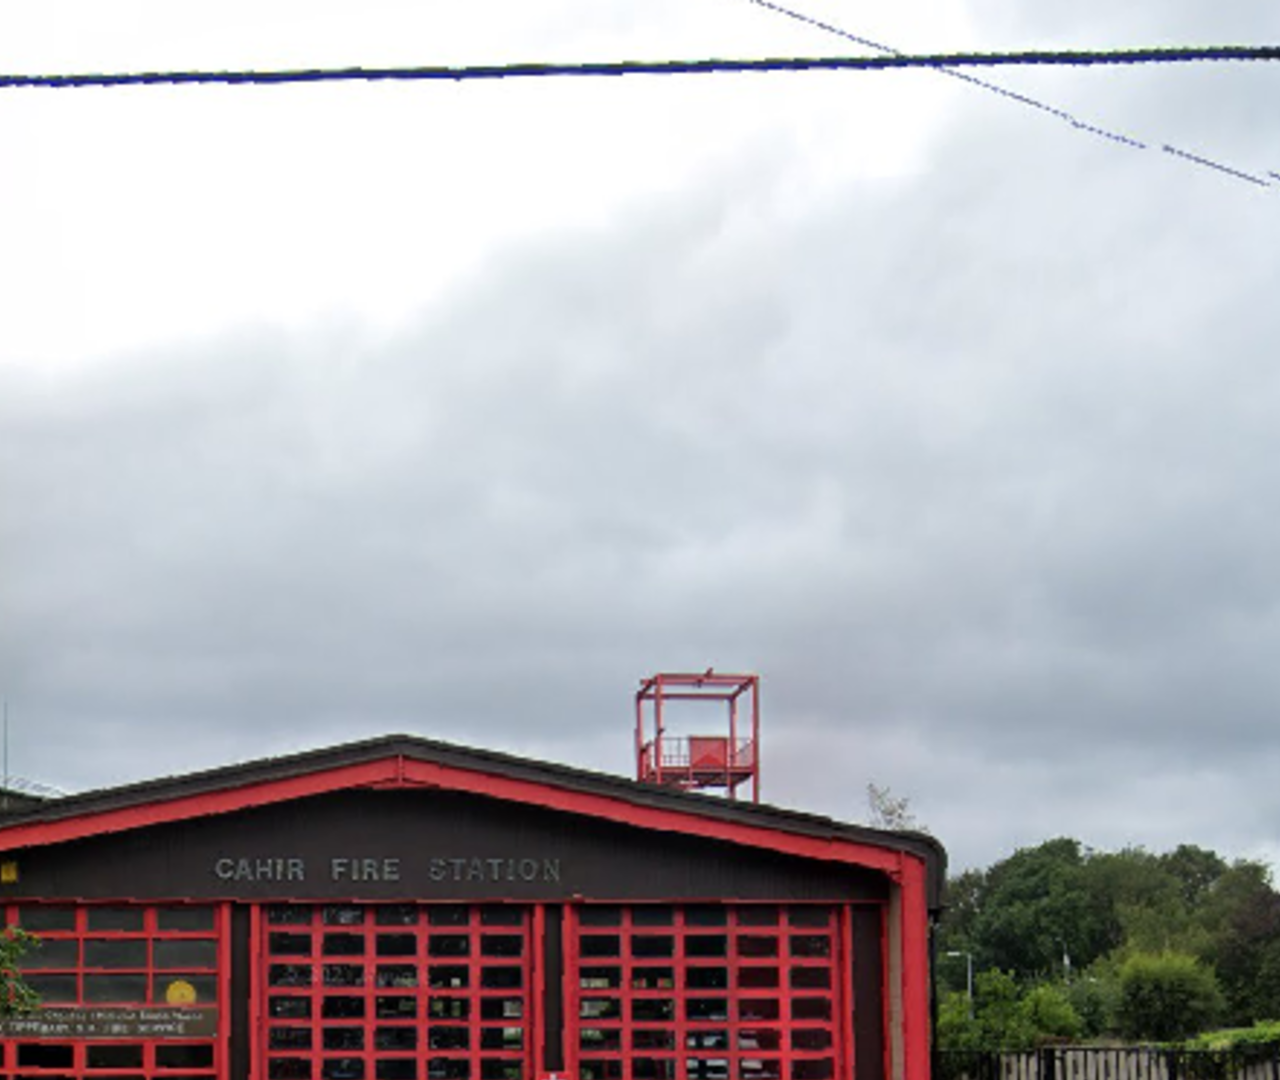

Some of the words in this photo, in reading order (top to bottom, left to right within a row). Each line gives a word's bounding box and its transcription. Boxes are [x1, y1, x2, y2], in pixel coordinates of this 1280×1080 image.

[215, 858, 305, 881] CAHIR
[331, 859, 400, 881] FIRE
[429, 858, 561, 882] STATION
